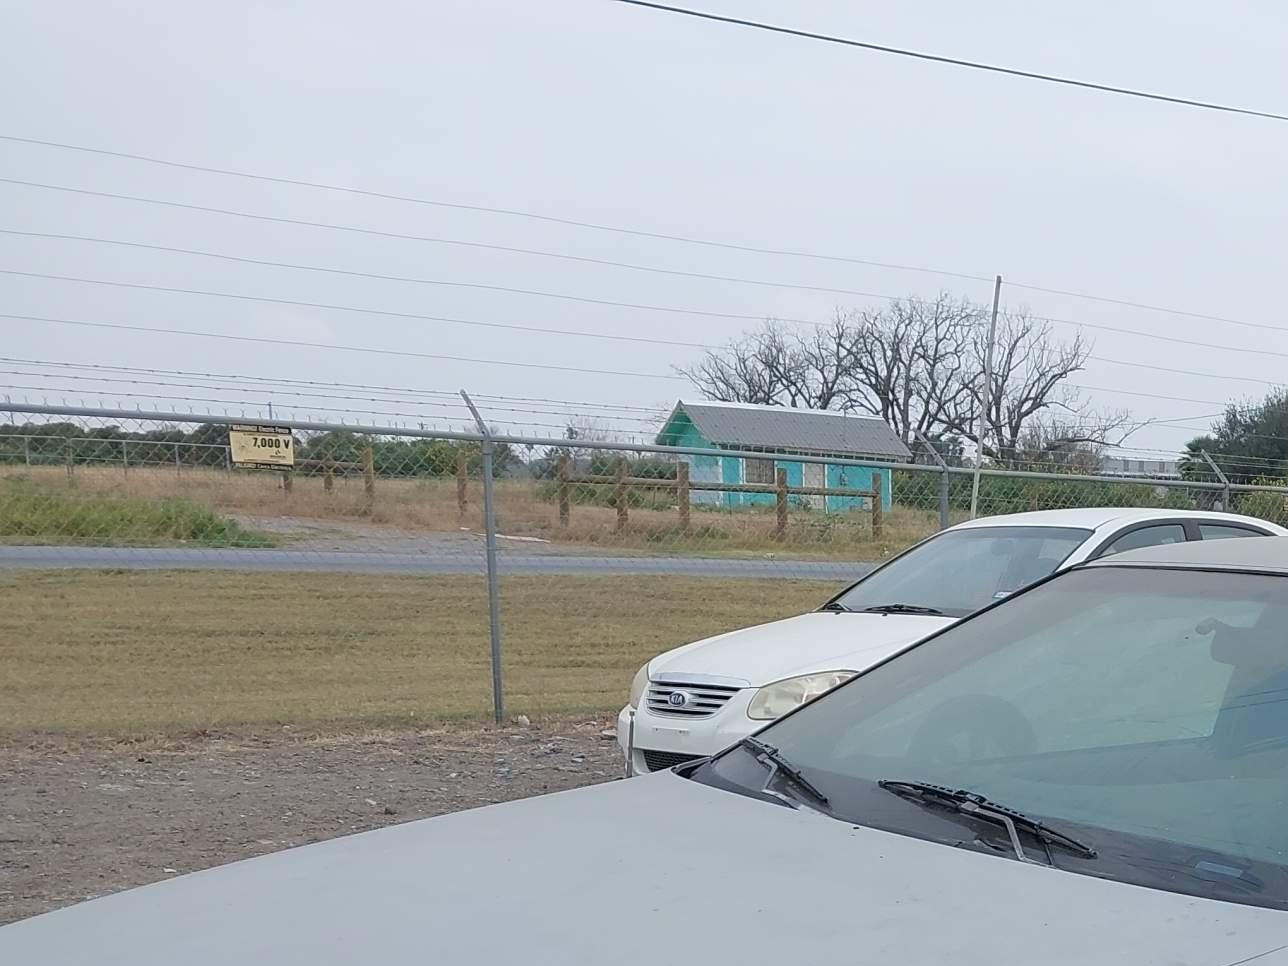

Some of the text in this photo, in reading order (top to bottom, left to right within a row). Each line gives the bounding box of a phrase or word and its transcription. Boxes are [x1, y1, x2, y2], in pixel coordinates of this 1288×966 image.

[252, 437, 290, 450] 7,000 V
[671, 695, 683, 705] KIA
